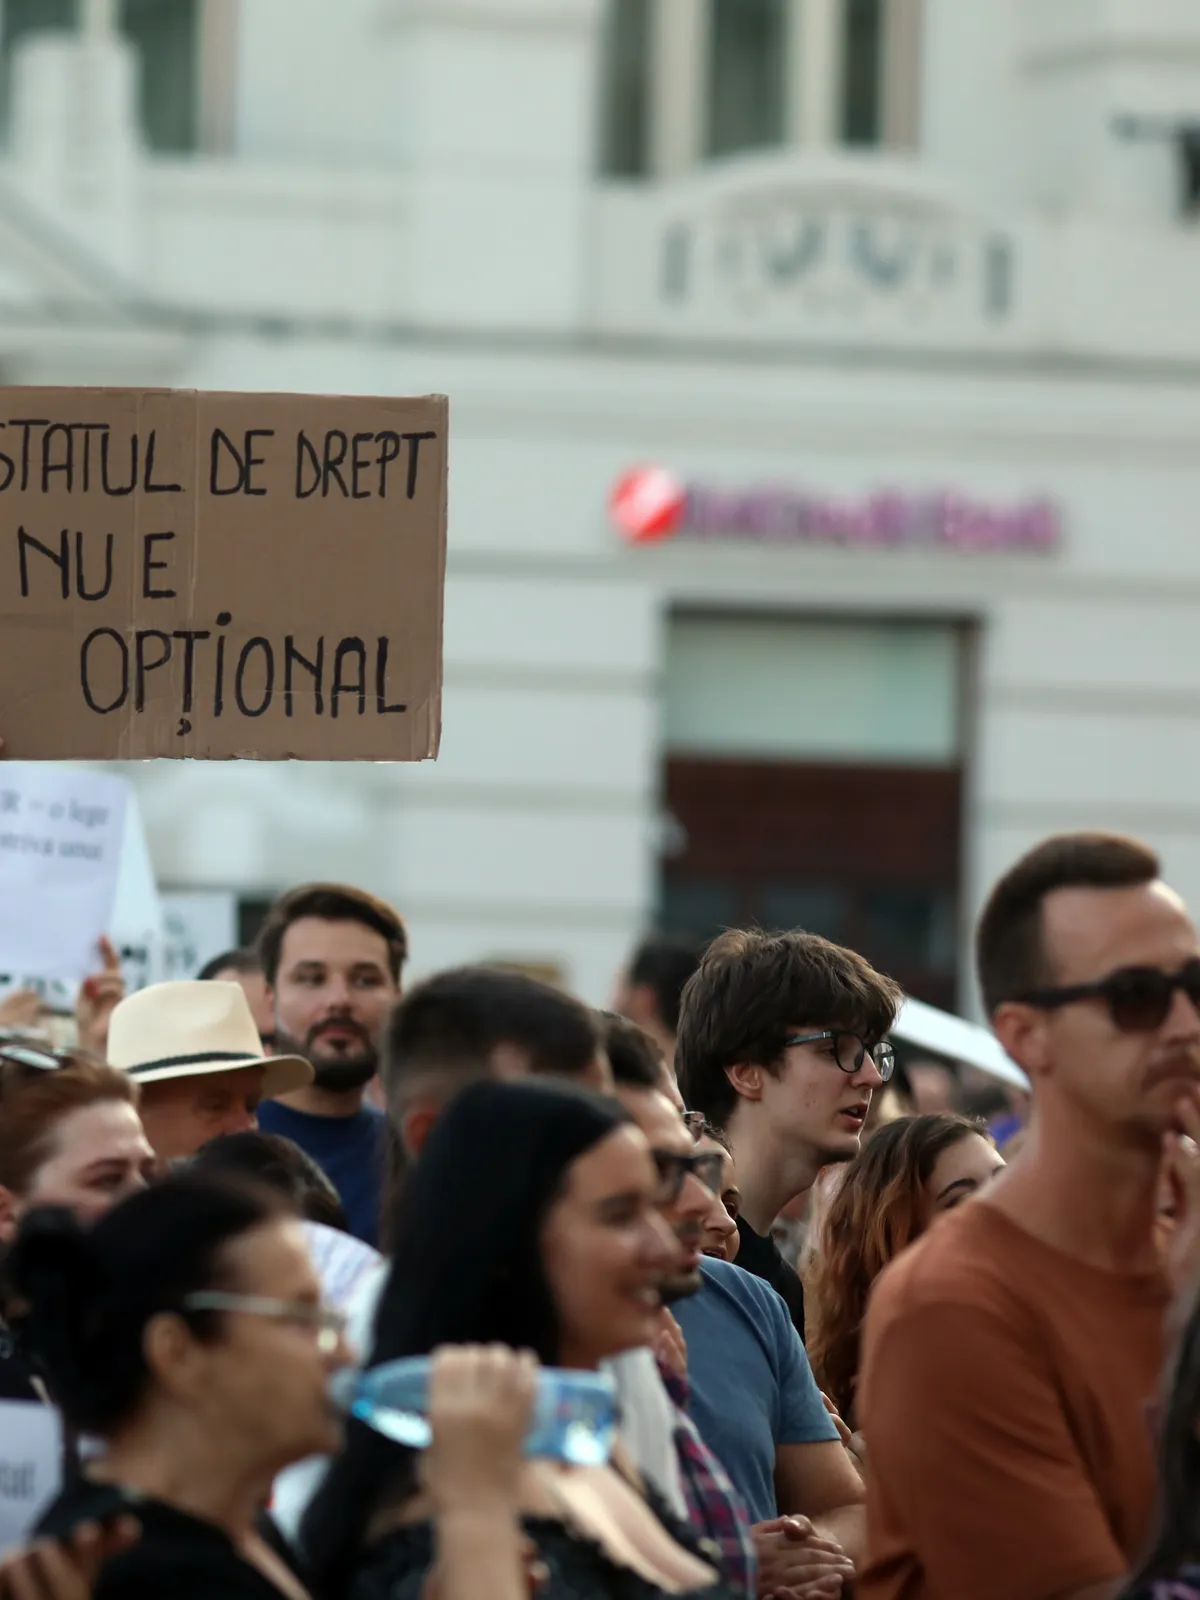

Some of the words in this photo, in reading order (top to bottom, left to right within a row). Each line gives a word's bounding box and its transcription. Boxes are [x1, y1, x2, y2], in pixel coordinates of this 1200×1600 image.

[209, 428, 276, 497] DE
[295, 428, 438, 500] DREPT
[16, 525, 114, 602] NU
[142, 531, 177, 599] E
